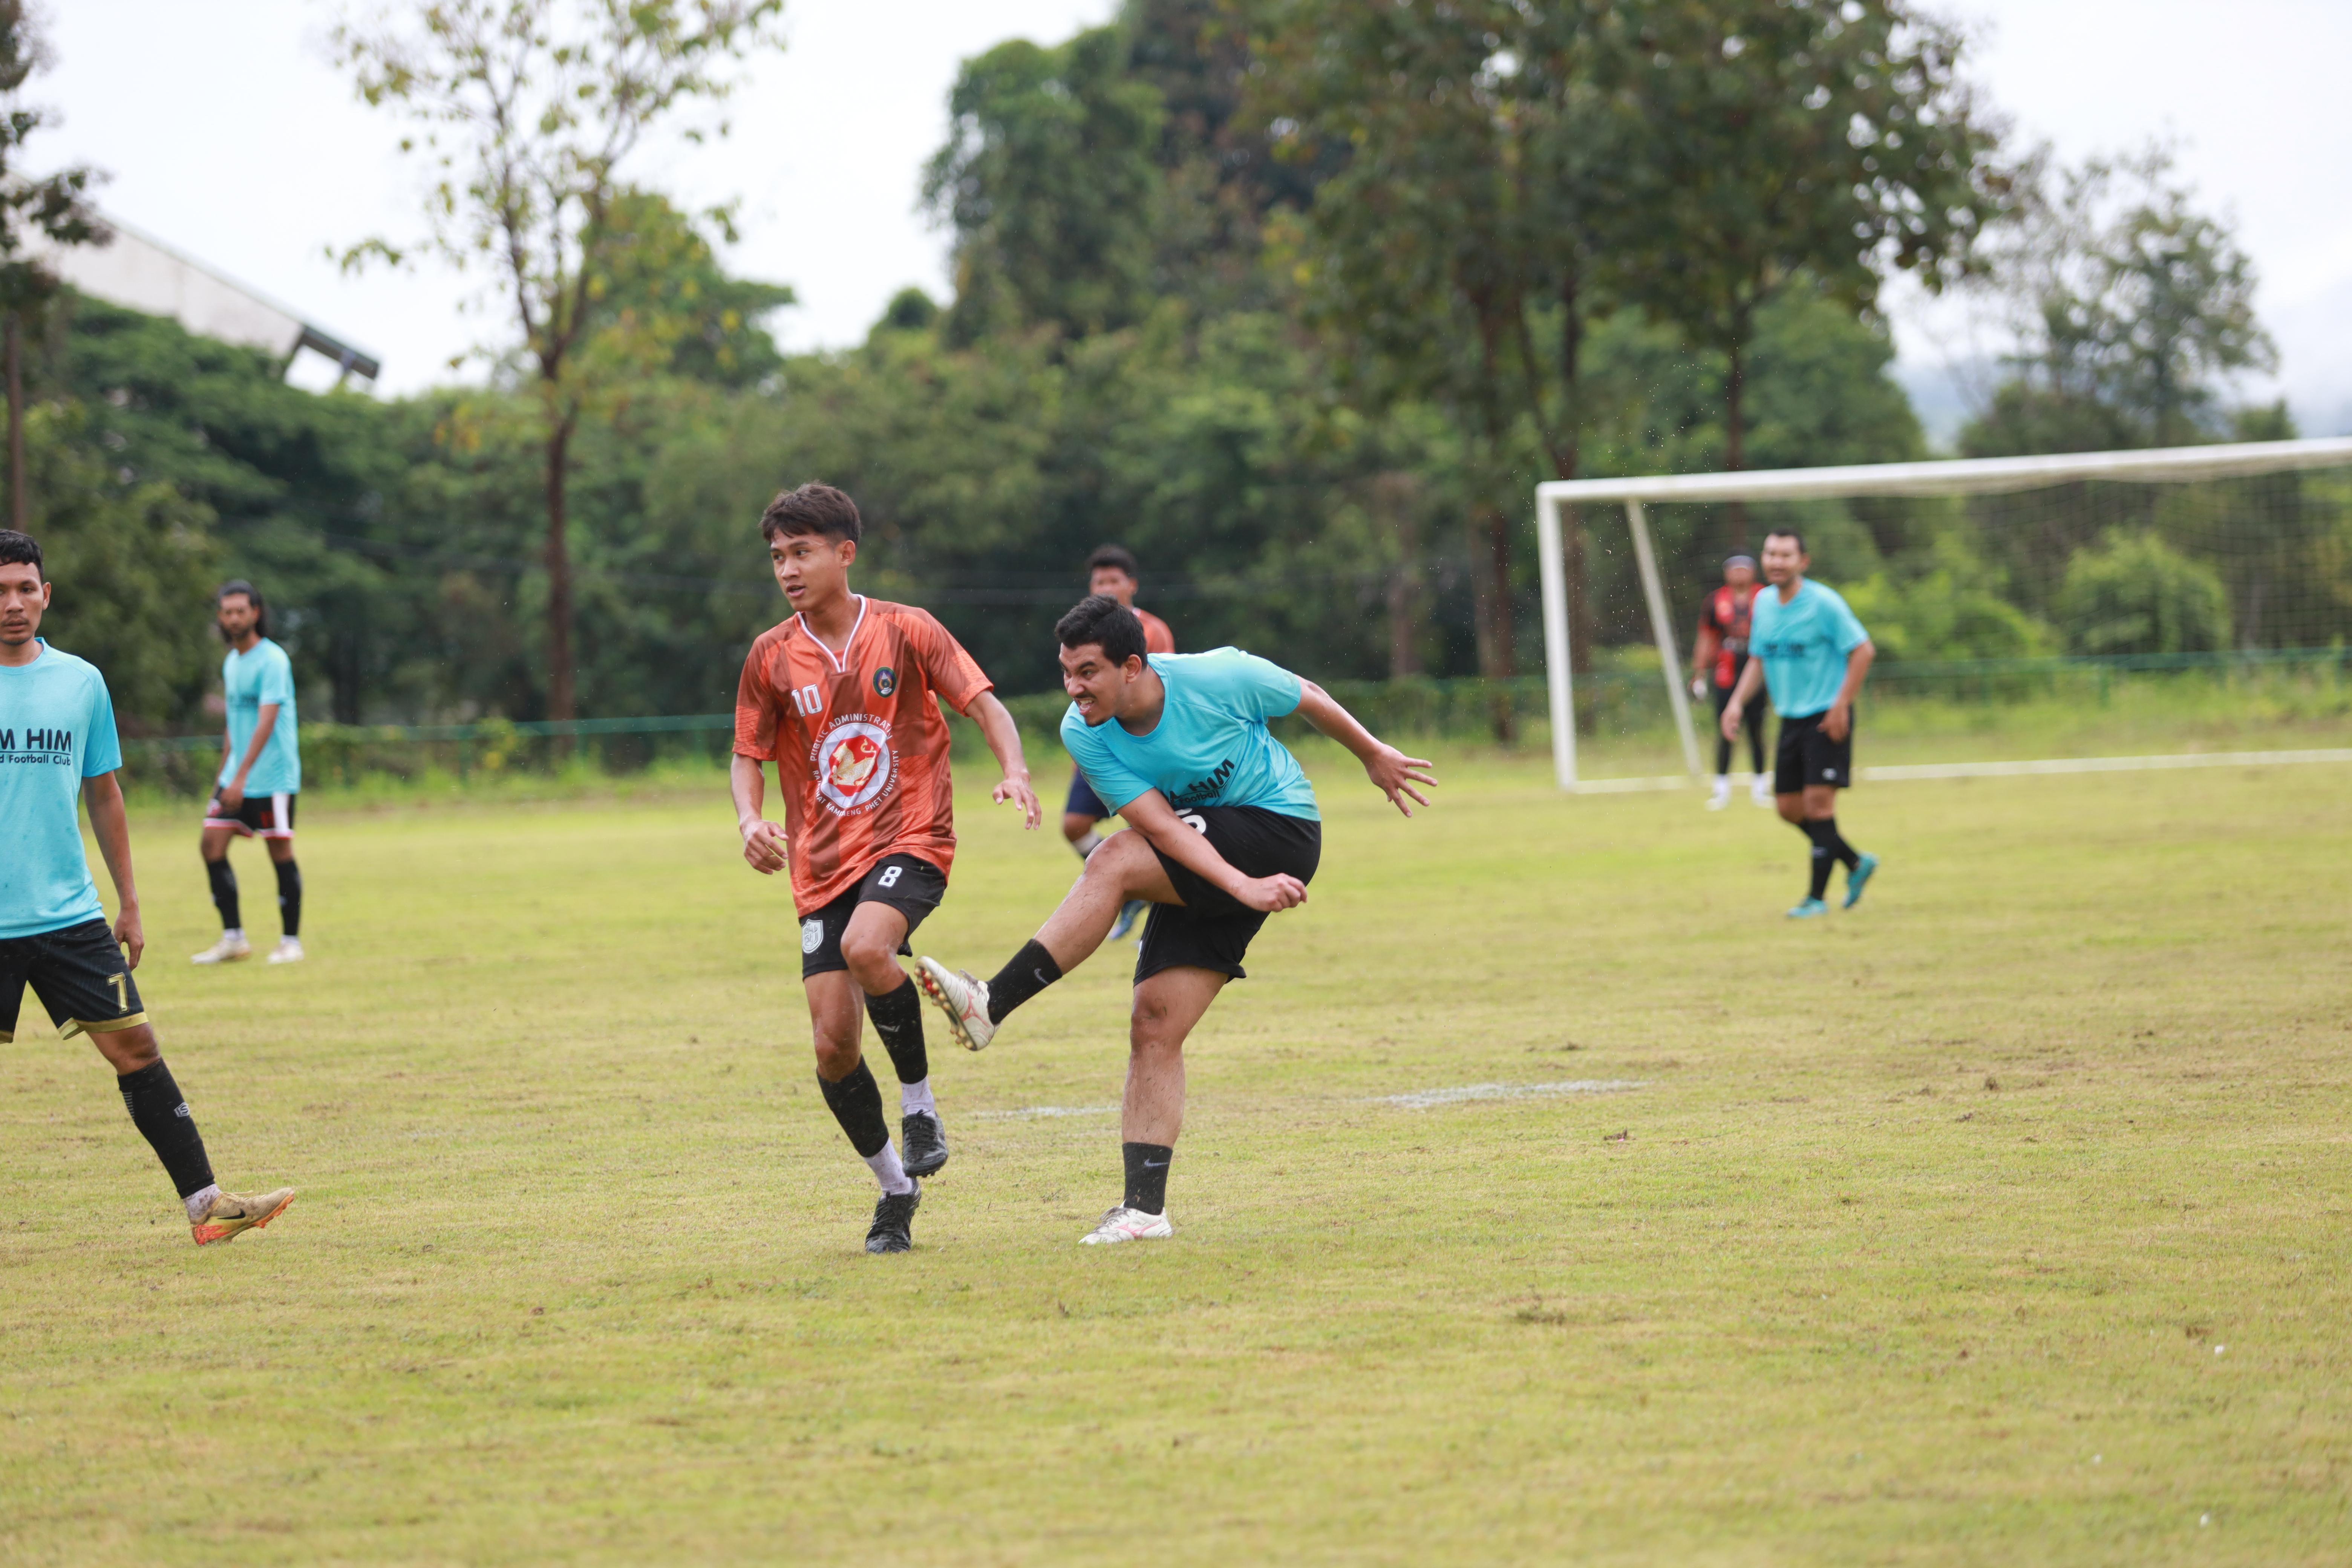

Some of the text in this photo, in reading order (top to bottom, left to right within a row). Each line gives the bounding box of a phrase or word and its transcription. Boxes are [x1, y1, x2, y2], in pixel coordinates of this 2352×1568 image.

[791, 683, 822, 717] 10
[27, 728, 71, 752] HIM
[810, 729, 828, 761] PUBLIC
[9, 754, 49, 764] Football
[53, 755, 71, 766] Club
[1188, 758, 1235, 791] HIM
[865, 796, 883, 812] PHET
[882, 750, 899, 796] UNIVERSITY
[878, 866, 902, 887] 8
[106, 972, 129, 1015] 7
